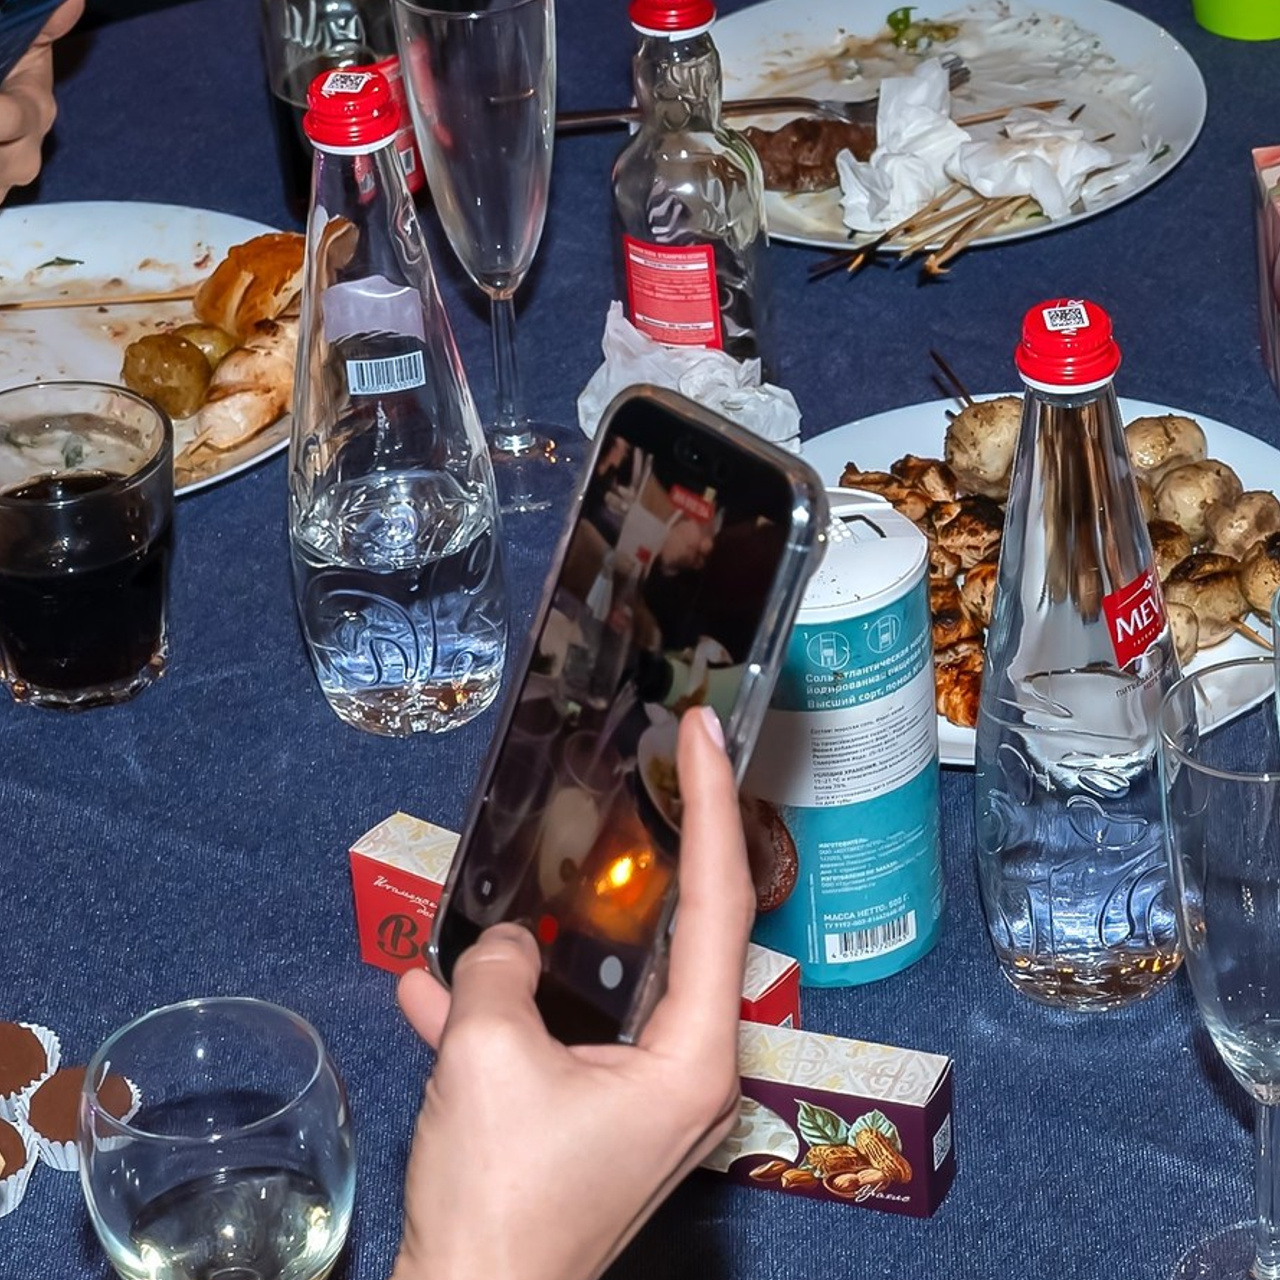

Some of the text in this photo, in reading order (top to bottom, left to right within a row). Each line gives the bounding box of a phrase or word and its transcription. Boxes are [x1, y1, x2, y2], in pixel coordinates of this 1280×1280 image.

[805, 673, 834, 683] Соль
[836, 646, 909, 681] тлантическая
[807, 695, 856, 709] Высший
[858, 687, 884, 701] сорт,
[823, 912, 856, 921] МАССА
